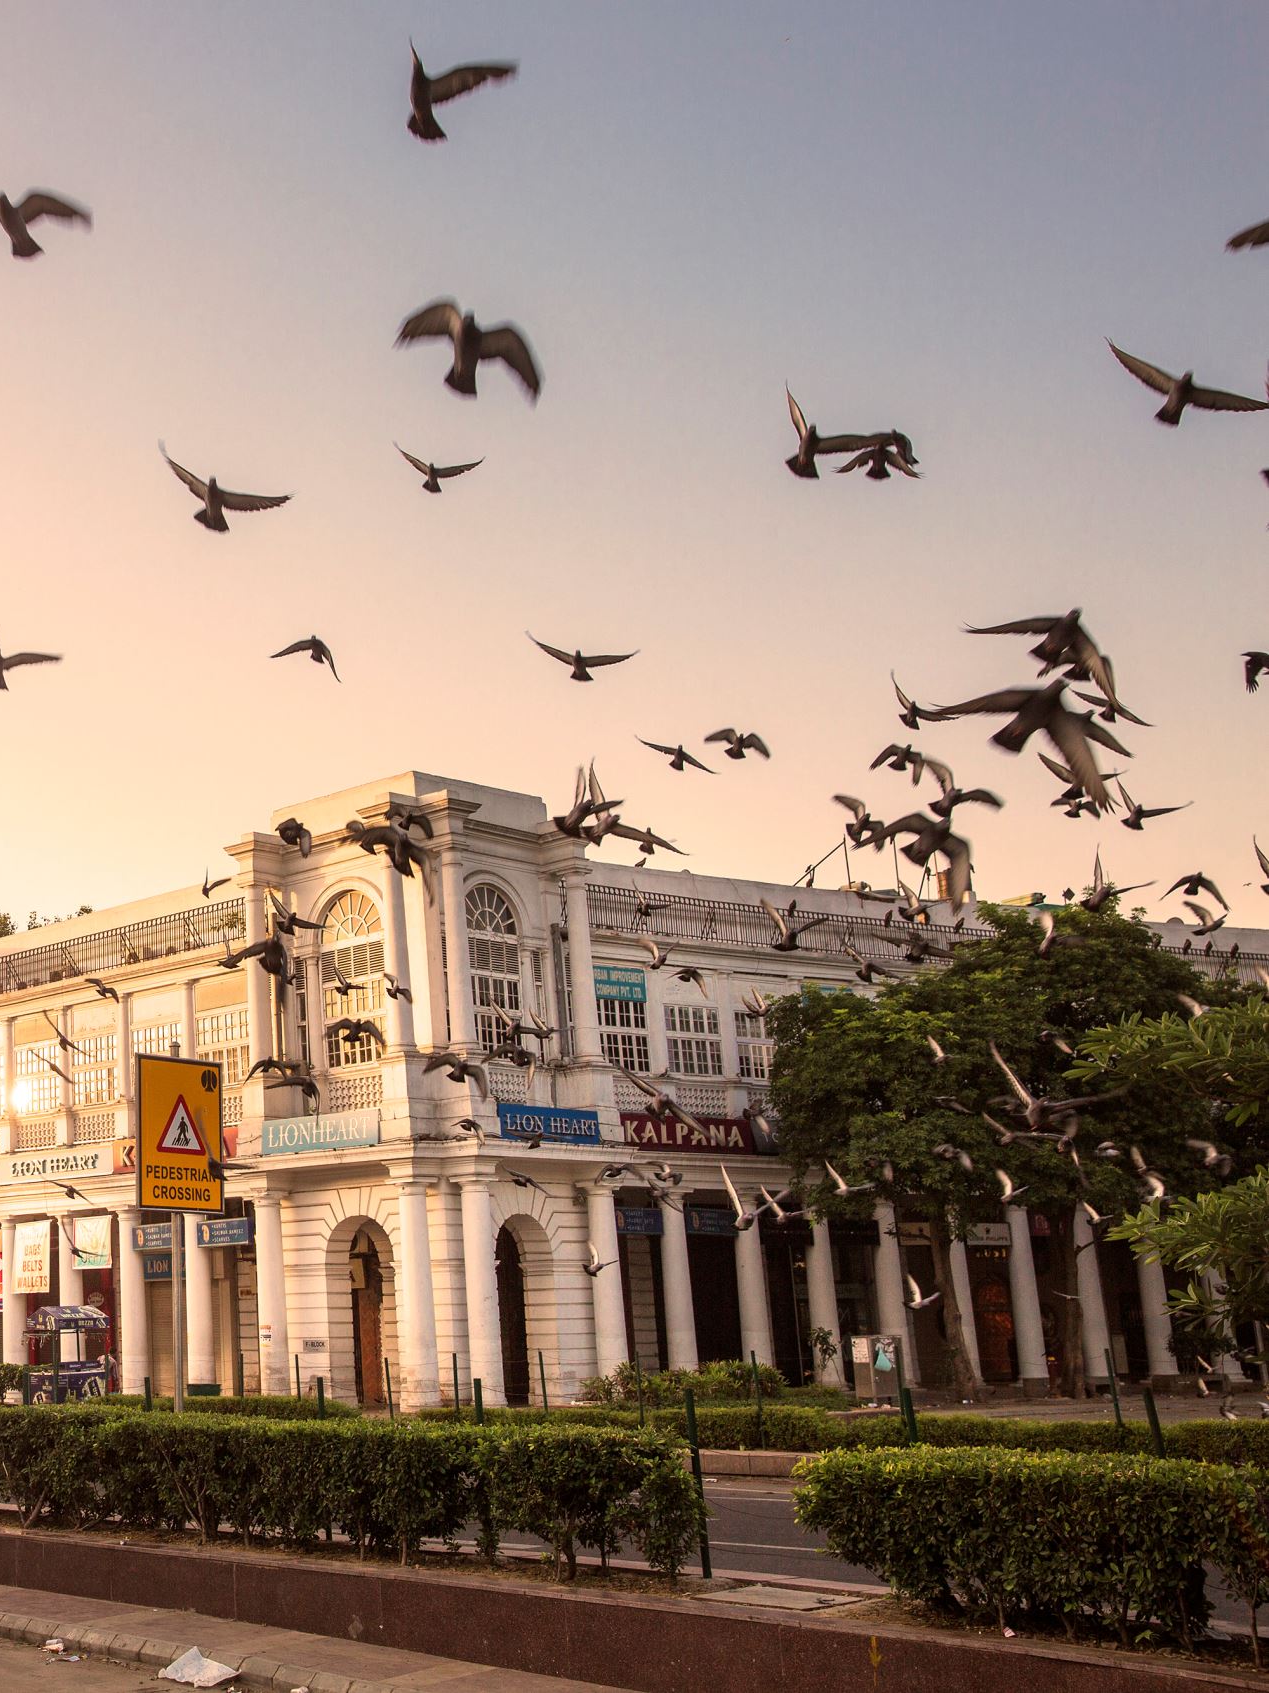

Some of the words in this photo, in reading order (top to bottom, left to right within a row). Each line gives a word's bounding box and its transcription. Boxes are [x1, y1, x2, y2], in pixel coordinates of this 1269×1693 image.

[593, 968, 608, 980] RBAN
[596, 983, 619, 995] COMPANY
[505, 1112, 544, 1132] LION
[549, 1116, 598, 1136] HEART
[268, 1116, 371, 1147] LIONHEART
[624, 1120, 745, 1148] KALPANA
[12, 1159, 47, 1177] LION
[50, 1153, 99, 1171] HEART
[152, 1185, 211, 1202] CROSSING
[24, 1244, 42, 1256] BAGS
[22, 1260, 43, 1273] BELTS
[147, 1260, 169, 1273] LION
[17, 1276, 48, 1289] WALLETS
